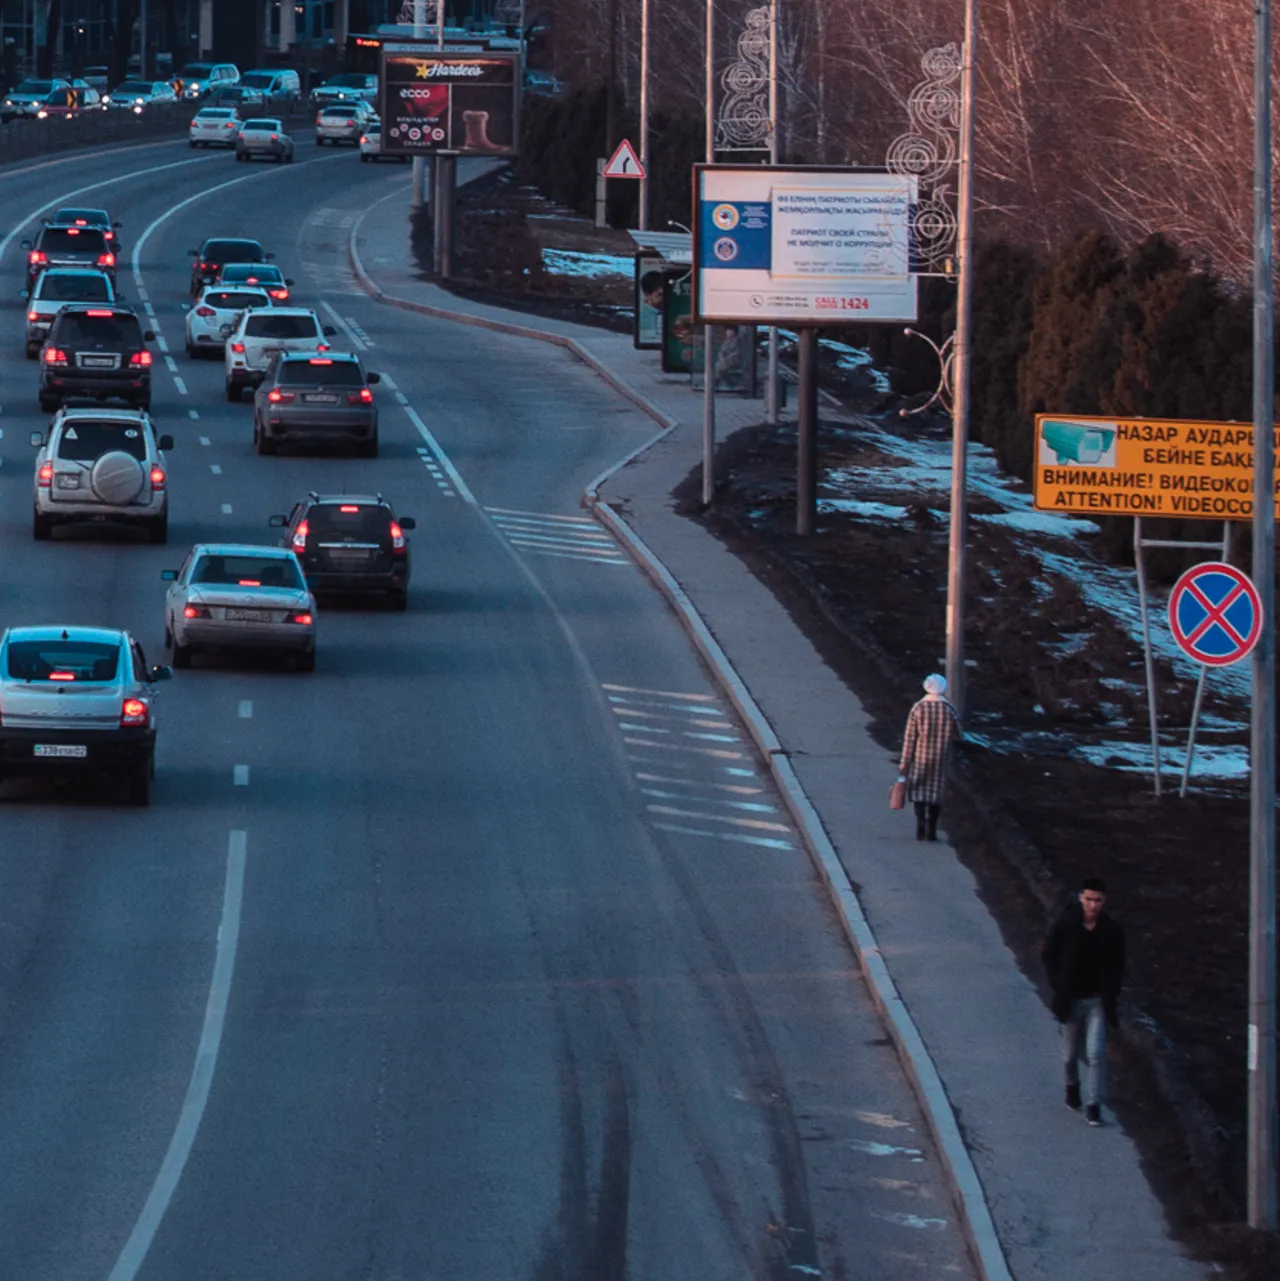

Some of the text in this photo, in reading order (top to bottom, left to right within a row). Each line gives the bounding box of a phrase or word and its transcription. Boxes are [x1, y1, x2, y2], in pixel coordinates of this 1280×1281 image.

[426, 63, 484, 77] Hardee's
[400, 89, 430, 98] ecco
[791, 228, 827, 236] ПАТРИОТ
[828, 228, 855, 237] СВОЕЙ
[841, 297, 869, 310] 1424
[1117, 425, 1280, 449] НАЗАР АУДАР
[1144, 445, 1205, 465] БЕЙНЕ
[1043, 470, 1153, 489] ВНИМАНИЕ!
[1055, 491, 1162, 510] ATTENTION!
